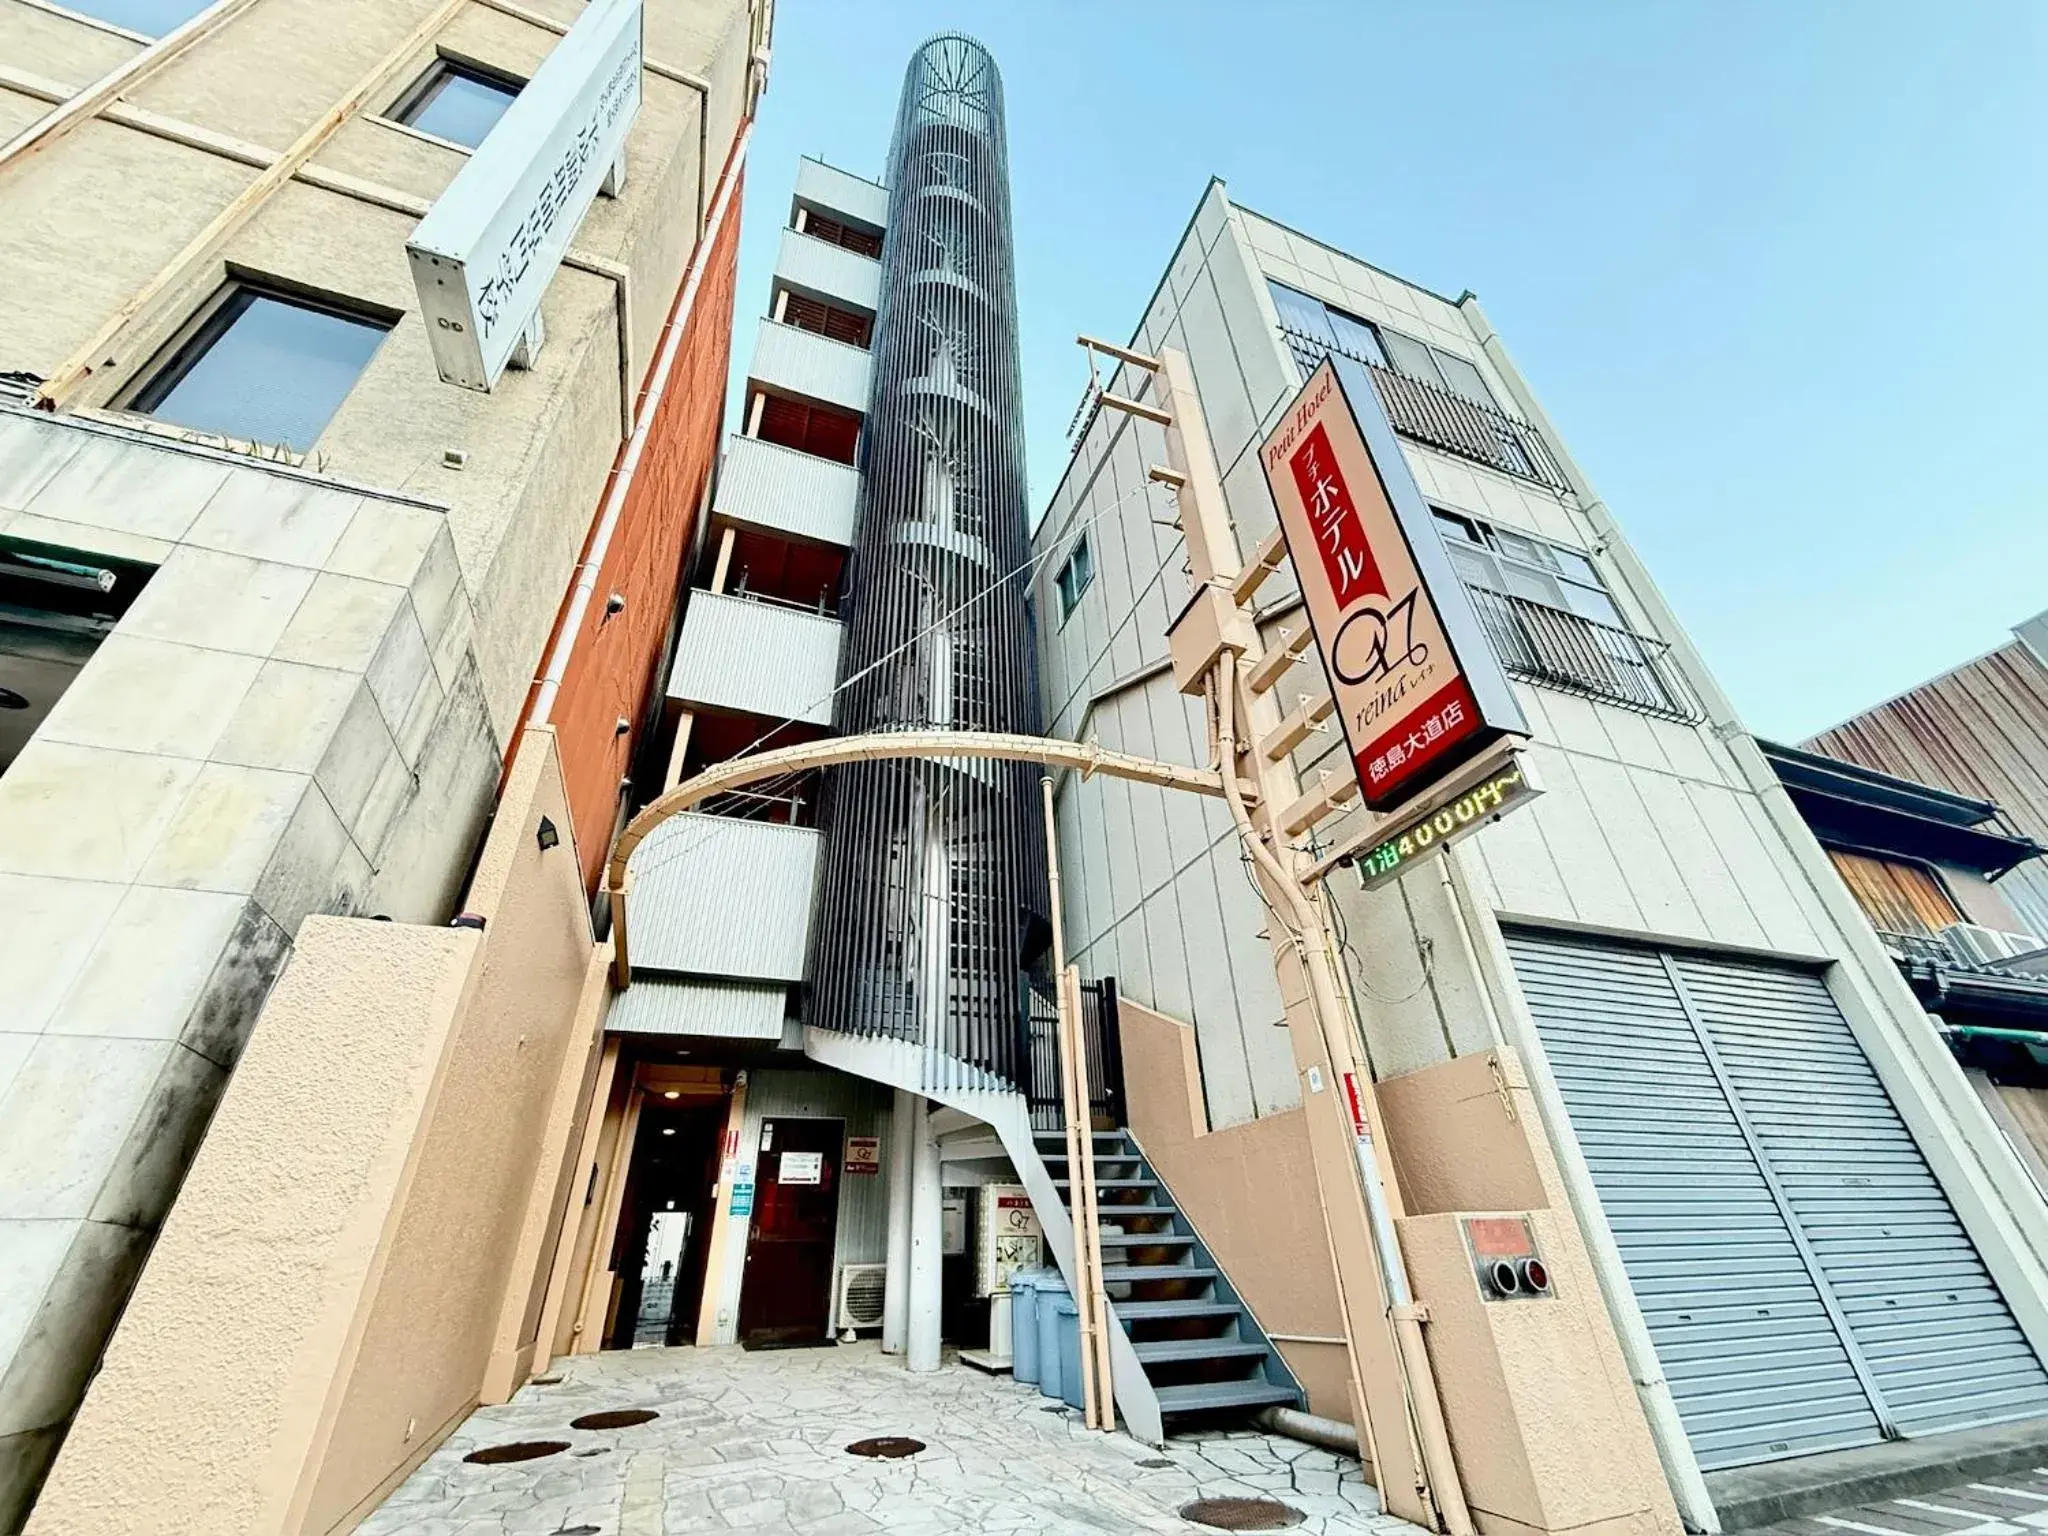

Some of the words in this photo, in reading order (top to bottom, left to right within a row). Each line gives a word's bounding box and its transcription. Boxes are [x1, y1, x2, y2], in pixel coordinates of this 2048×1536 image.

[1268, 427, 1295, 472] Petit
[1296, 373, 1333, 434] Hotel
[1356, 671, 1407, 732] reina
[1369, 699, 1464, 784] 徳島大道店
